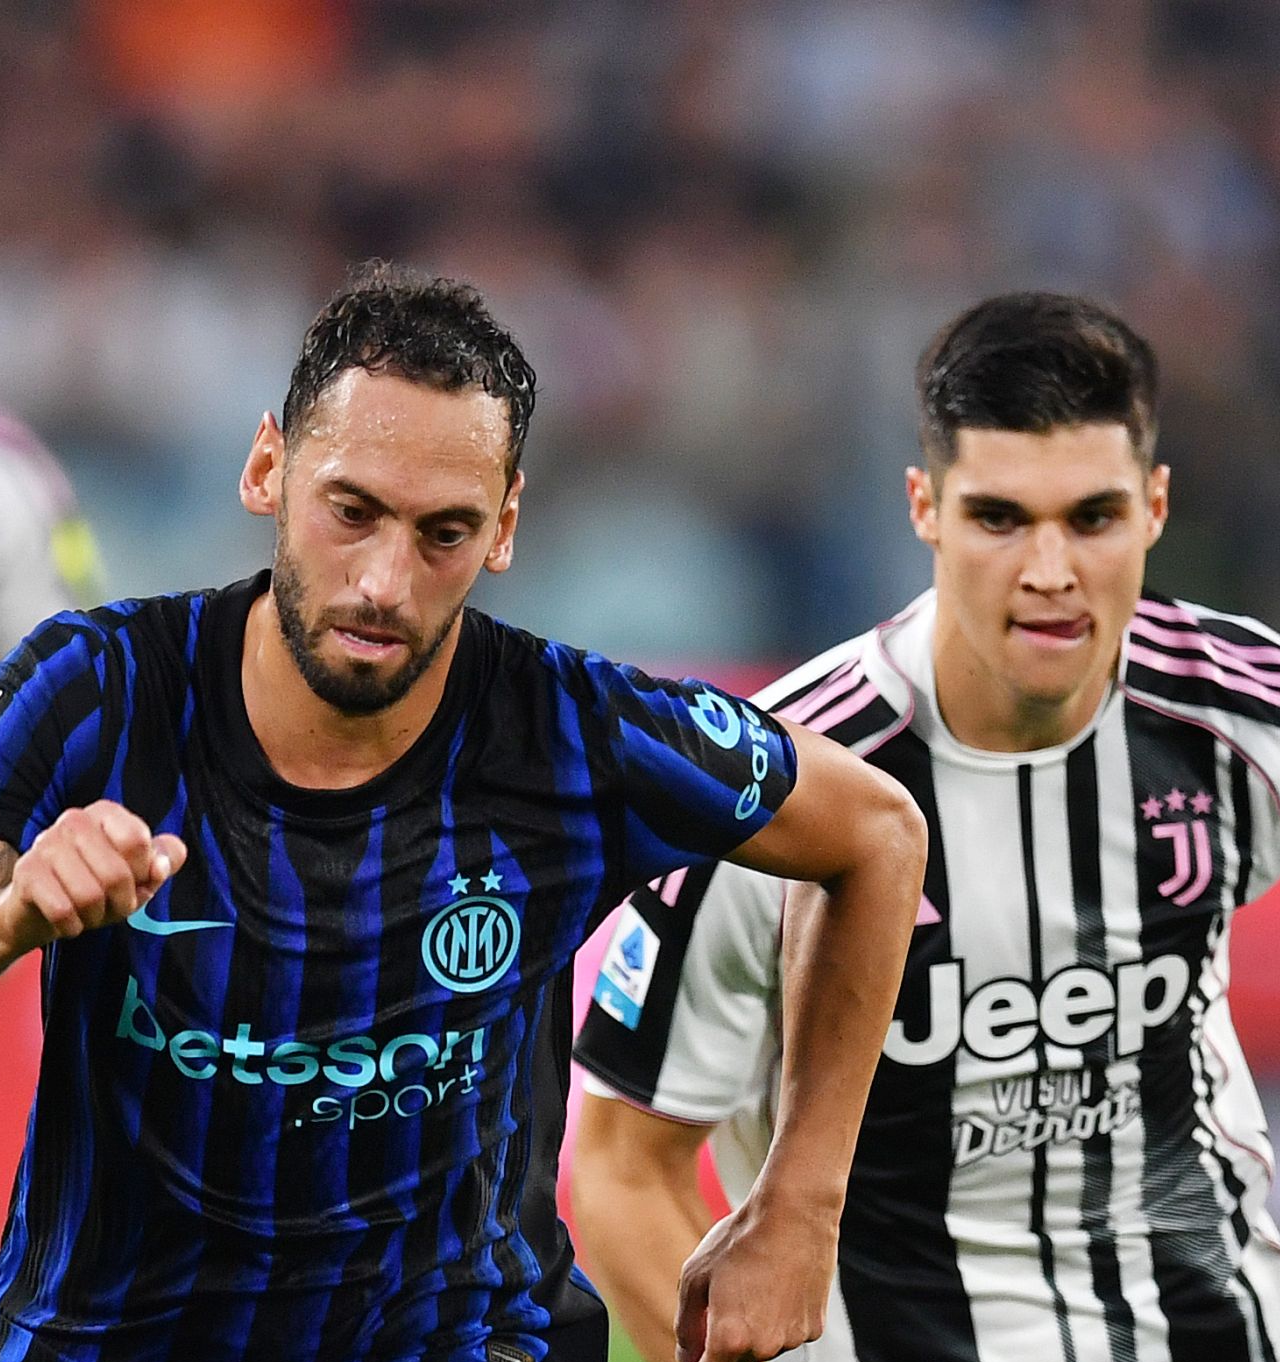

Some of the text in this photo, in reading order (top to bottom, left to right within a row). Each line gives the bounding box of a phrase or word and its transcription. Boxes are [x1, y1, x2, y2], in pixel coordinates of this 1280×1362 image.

[116, 974, 485, 1086] betsson
[882, 953, 1191, 1067] Jeep
[954, 1086, 1142, 1168] Detroit
